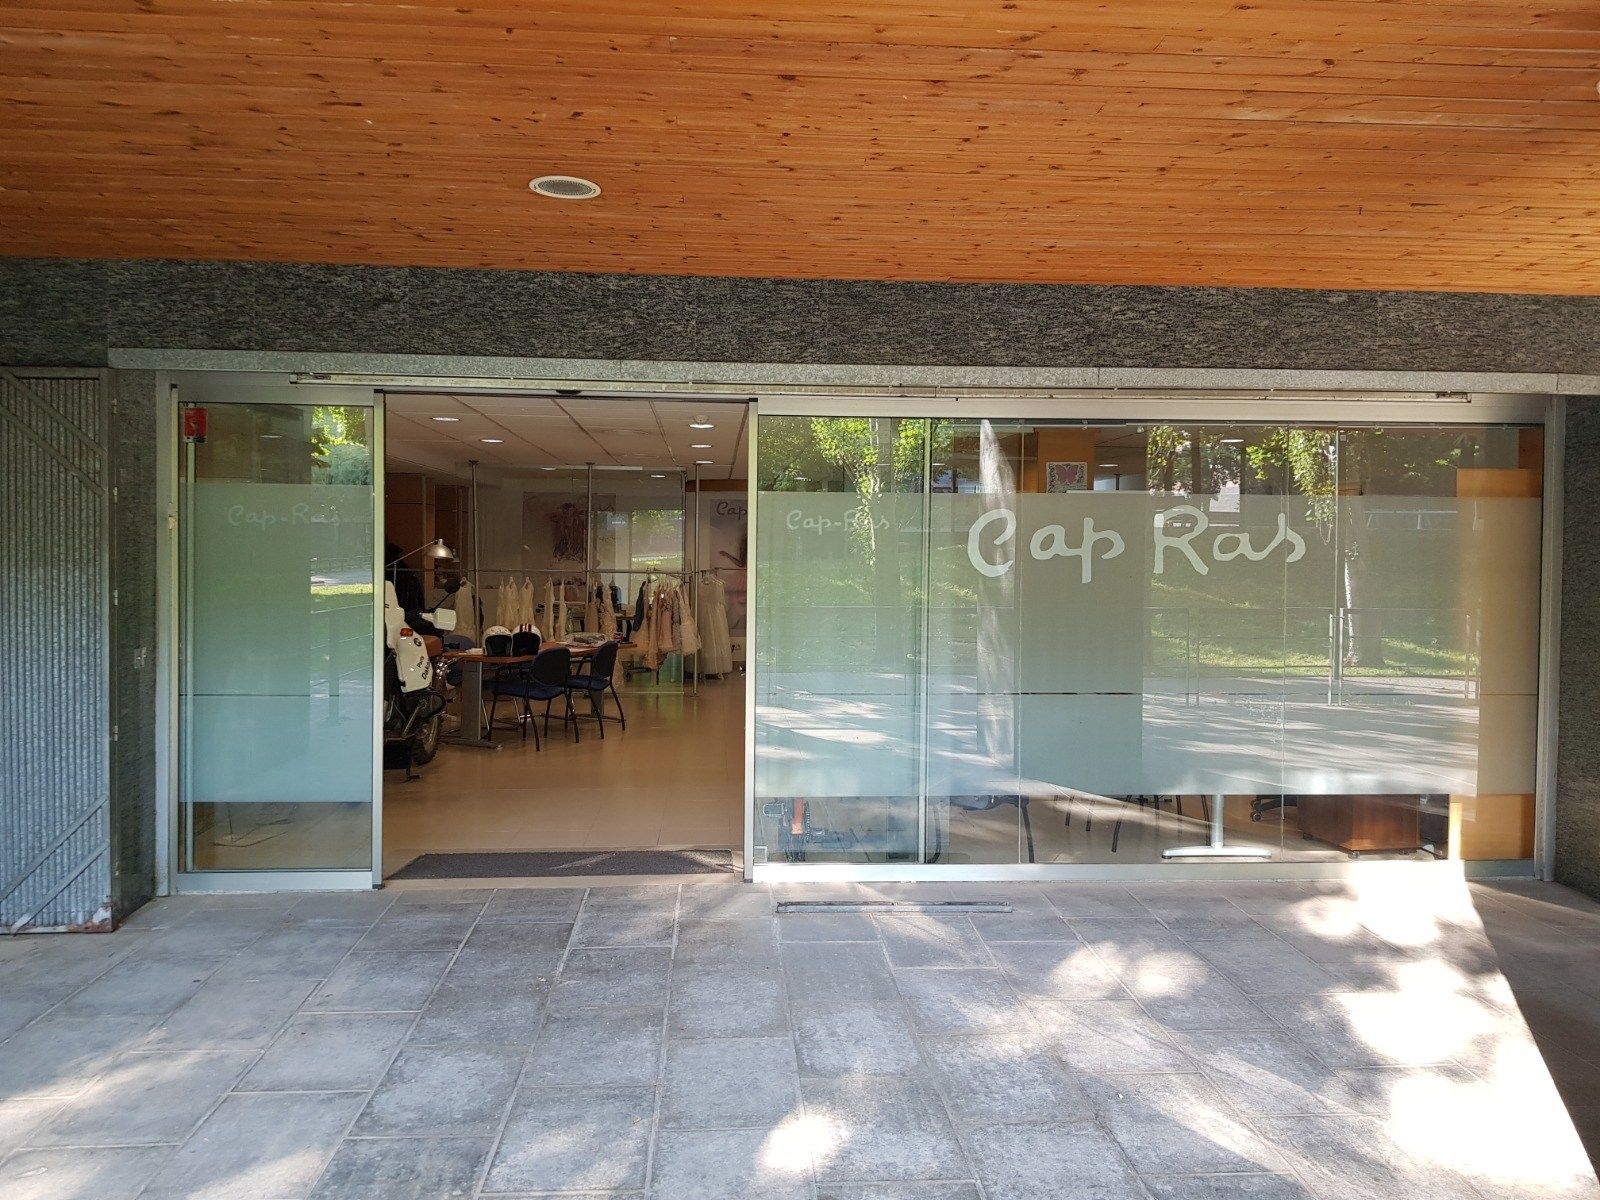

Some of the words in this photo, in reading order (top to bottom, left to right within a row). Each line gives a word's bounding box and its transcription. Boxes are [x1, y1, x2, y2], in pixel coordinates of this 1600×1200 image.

[716, 501, 748, 520] Cap
[967, 508, 1126, 584] Cap
[1153, 504, 1306, 576] Ras
